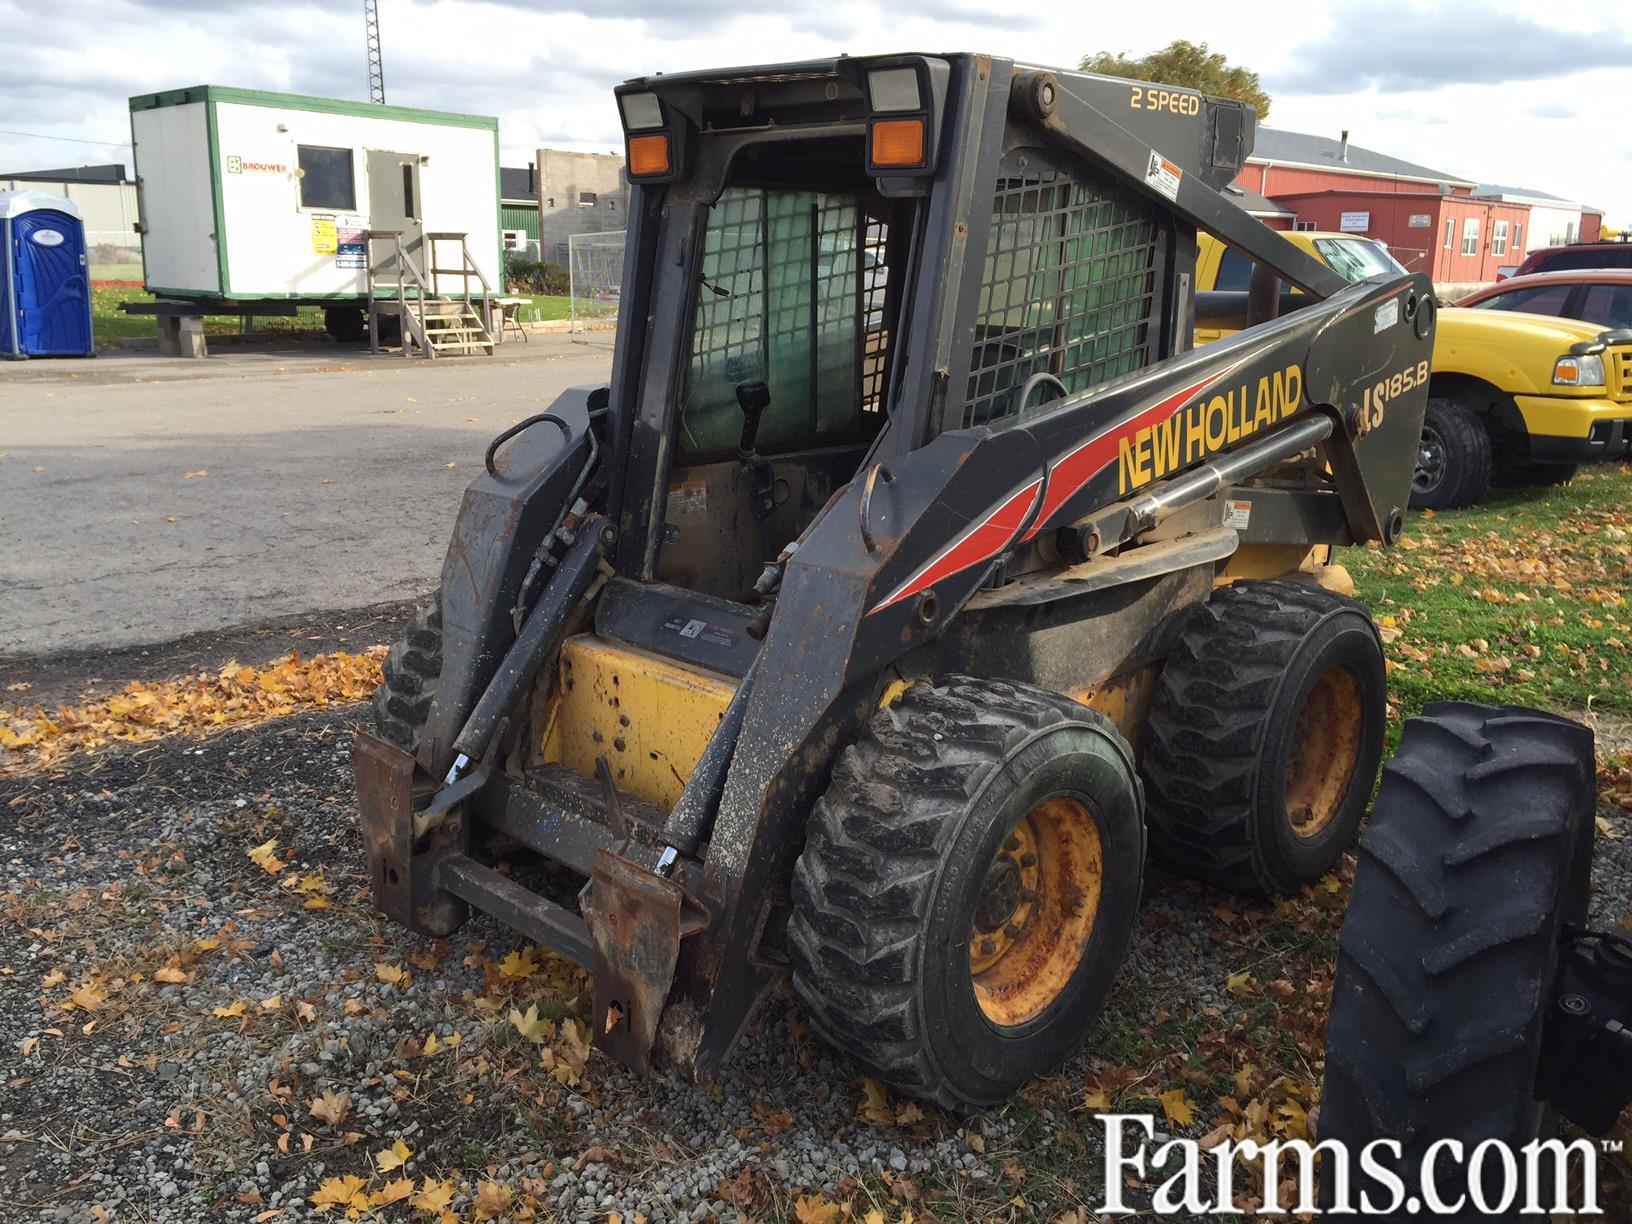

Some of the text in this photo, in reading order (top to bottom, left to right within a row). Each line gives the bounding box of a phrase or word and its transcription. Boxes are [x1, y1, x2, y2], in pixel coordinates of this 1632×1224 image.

[1130, 86, 1200, 116] 2 SPEED
[1118, 363, 1302, 496] NEW HOLLAND
